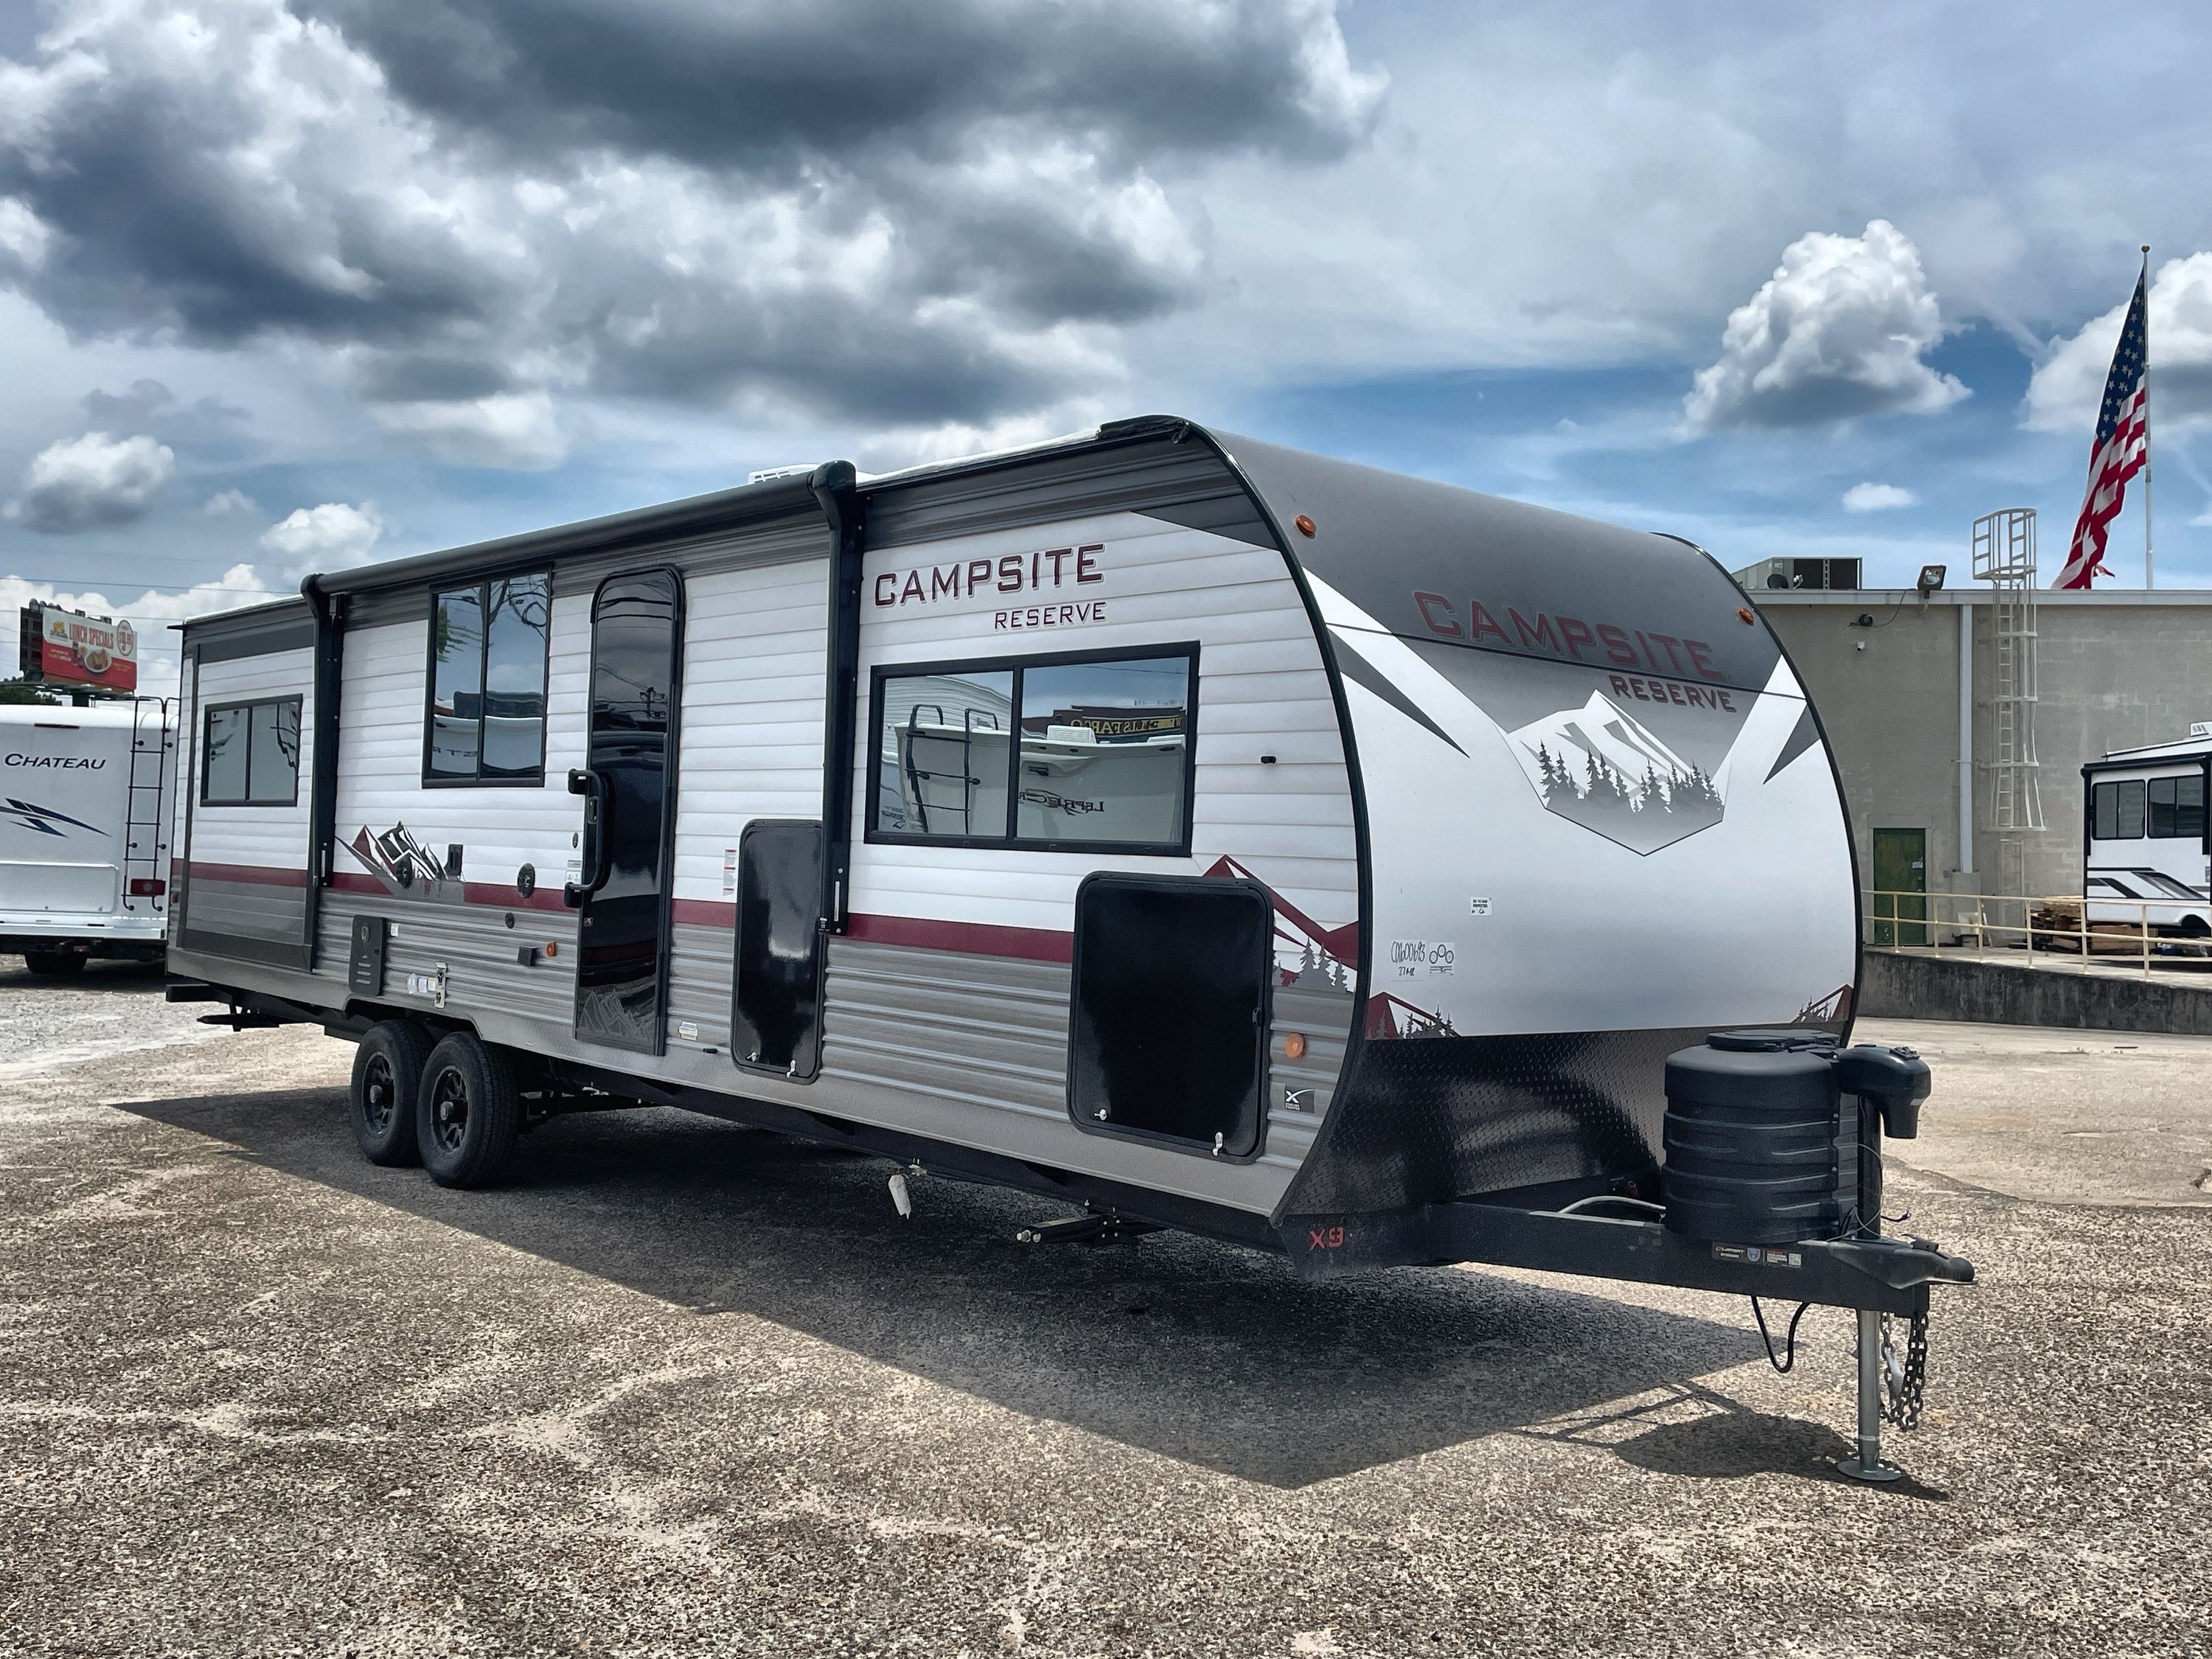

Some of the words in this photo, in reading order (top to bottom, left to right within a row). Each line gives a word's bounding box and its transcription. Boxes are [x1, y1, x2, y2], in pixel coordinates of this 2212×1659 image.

[874, 543, 1105, 607] CAMPSITE
[994, 601, 1107, 630] RESERVE
[1413, 590, 1727, 680] CAMPSITE
[1608, 675, 1738, 713] RESERVE
[4, 753, 106, 770] CHATEAU
